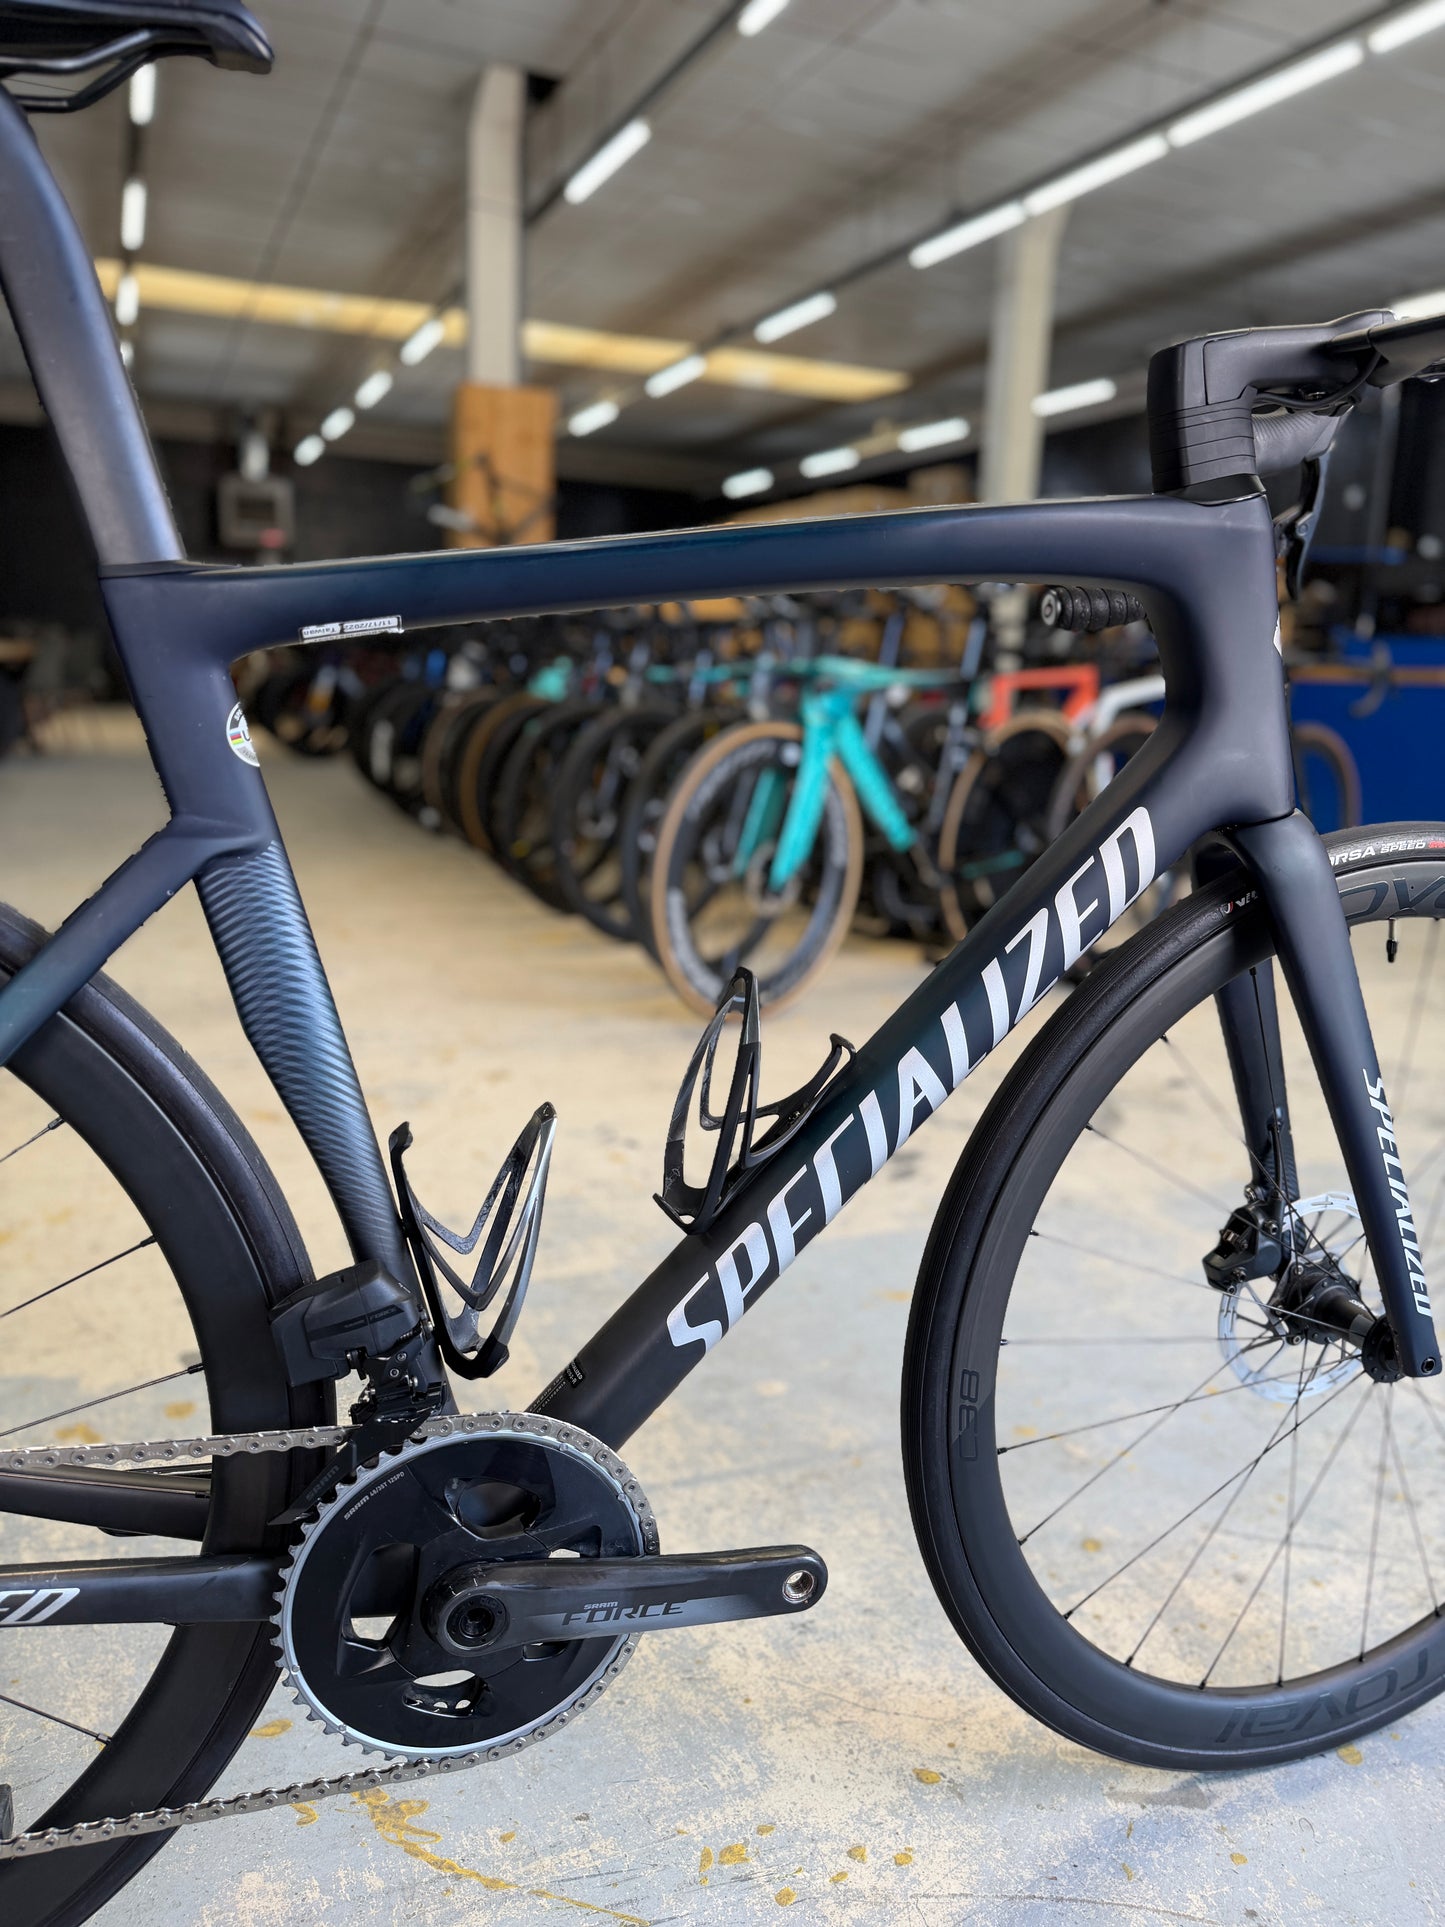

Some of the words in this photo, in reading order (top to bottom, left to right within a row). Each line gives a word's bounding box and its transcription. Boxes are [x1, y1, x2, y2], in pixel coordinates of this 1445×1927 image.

[1380, 841, 1426, 853] SPEED
[667, 806, 1156, 1353] SPECIALIZED
[1363, 1068, 1433, 1318] SPECIALIZED
[305, 1464, 341, 1501] SRAM
[343, 1495, 370, 1521] SRAM
[561, 1598, 689, 1626] FORCE
[583, 1601, 619, 1610] SRAM
